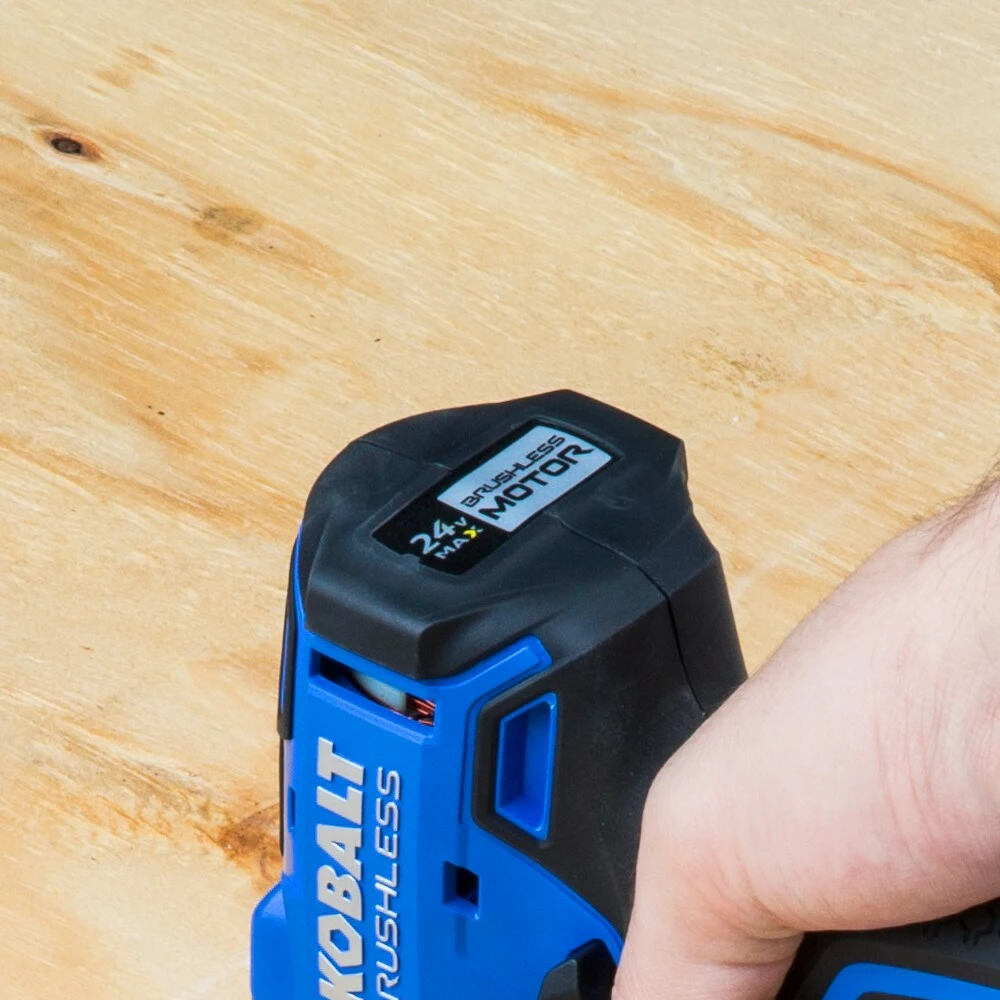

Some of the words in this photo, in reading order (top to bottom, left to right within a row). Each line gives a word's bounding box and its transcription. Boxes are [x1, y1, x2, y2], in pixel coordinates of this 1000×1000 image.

[460, 434, 566, 508] BRUSHLESS
[477, 444, 595, 521] MOTOR
[433, 525, 484, 560] MAX
